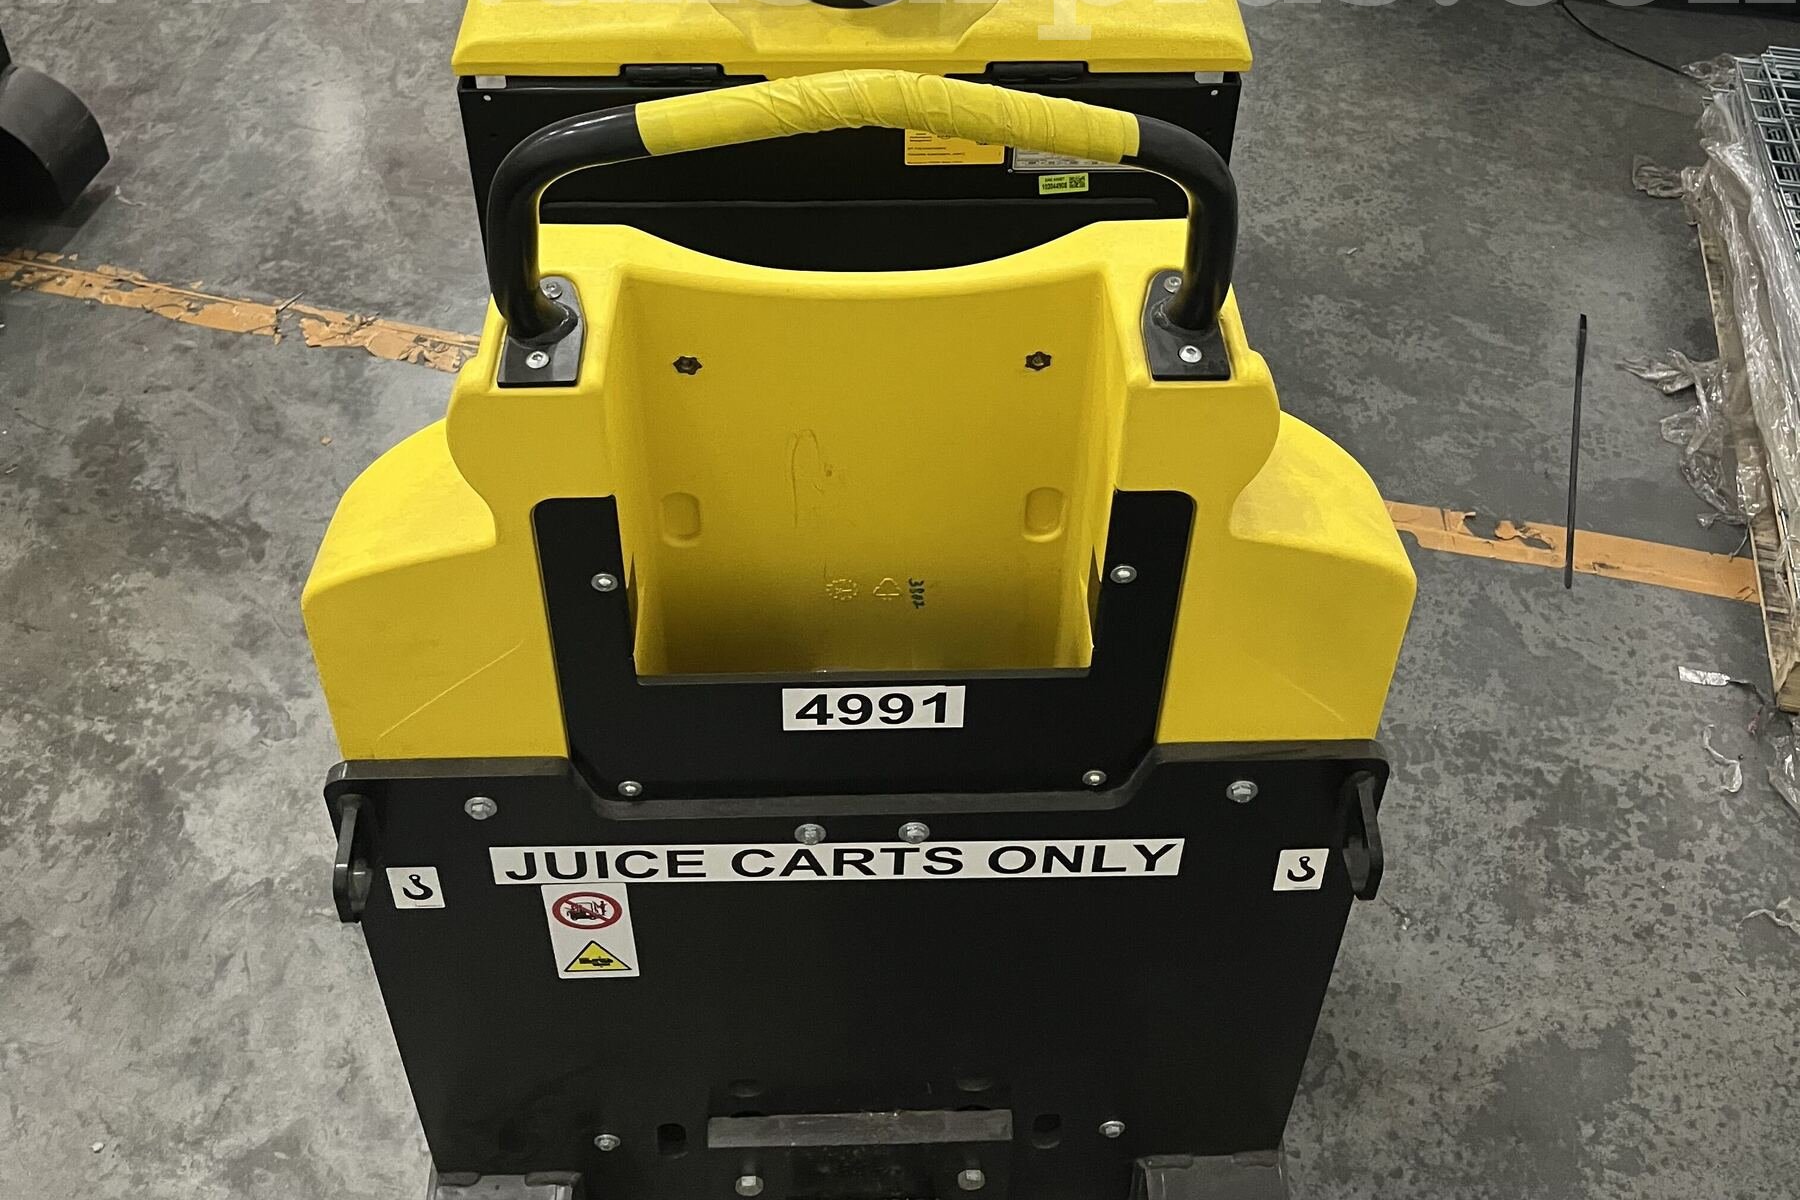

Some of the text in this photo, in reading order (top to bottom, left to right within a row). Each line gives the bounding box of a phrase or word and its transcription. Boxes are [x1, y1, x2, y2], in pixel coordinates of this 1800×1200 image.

[795, 691, 948, 726] 4991
[504, 843, 1177, 881] JUICE CARTS ONLY
